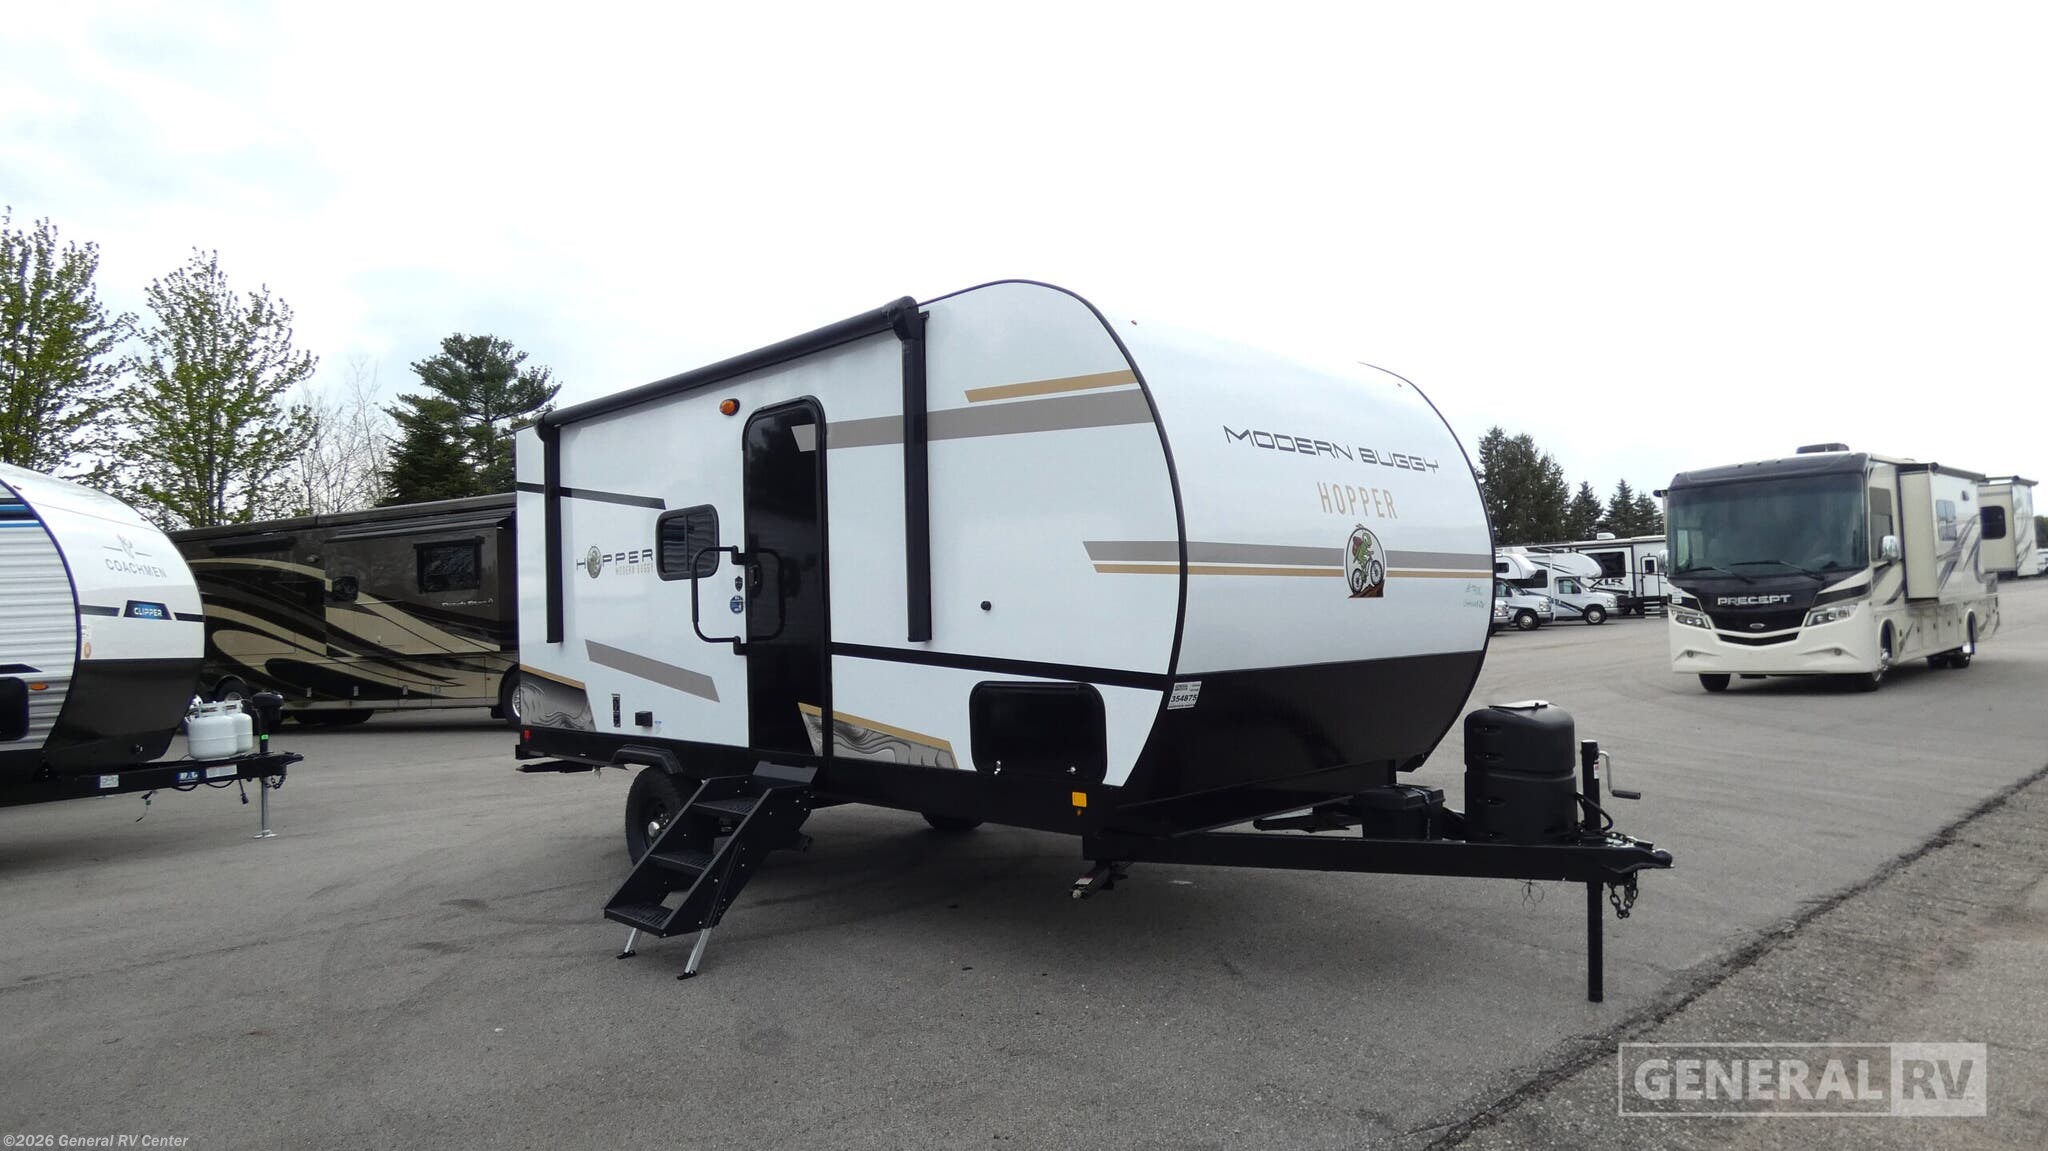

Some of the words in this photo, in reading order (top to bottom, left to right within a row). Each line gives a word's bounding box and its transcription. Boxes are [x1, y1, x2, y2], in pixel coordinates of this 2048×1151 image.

[1223, 425, 1354, 462] MODERN
[1358, 447, 1439, 473] BUGGY
[1316, 481, 1398, 519] HOPPER
[105, 558, 168, 578] COACHMEN
[1717, 594, 1791, 606] PRECEPT
[134, 607, 162, 617] CLIPPER
[1170, 694, 1198, 703] 354875
